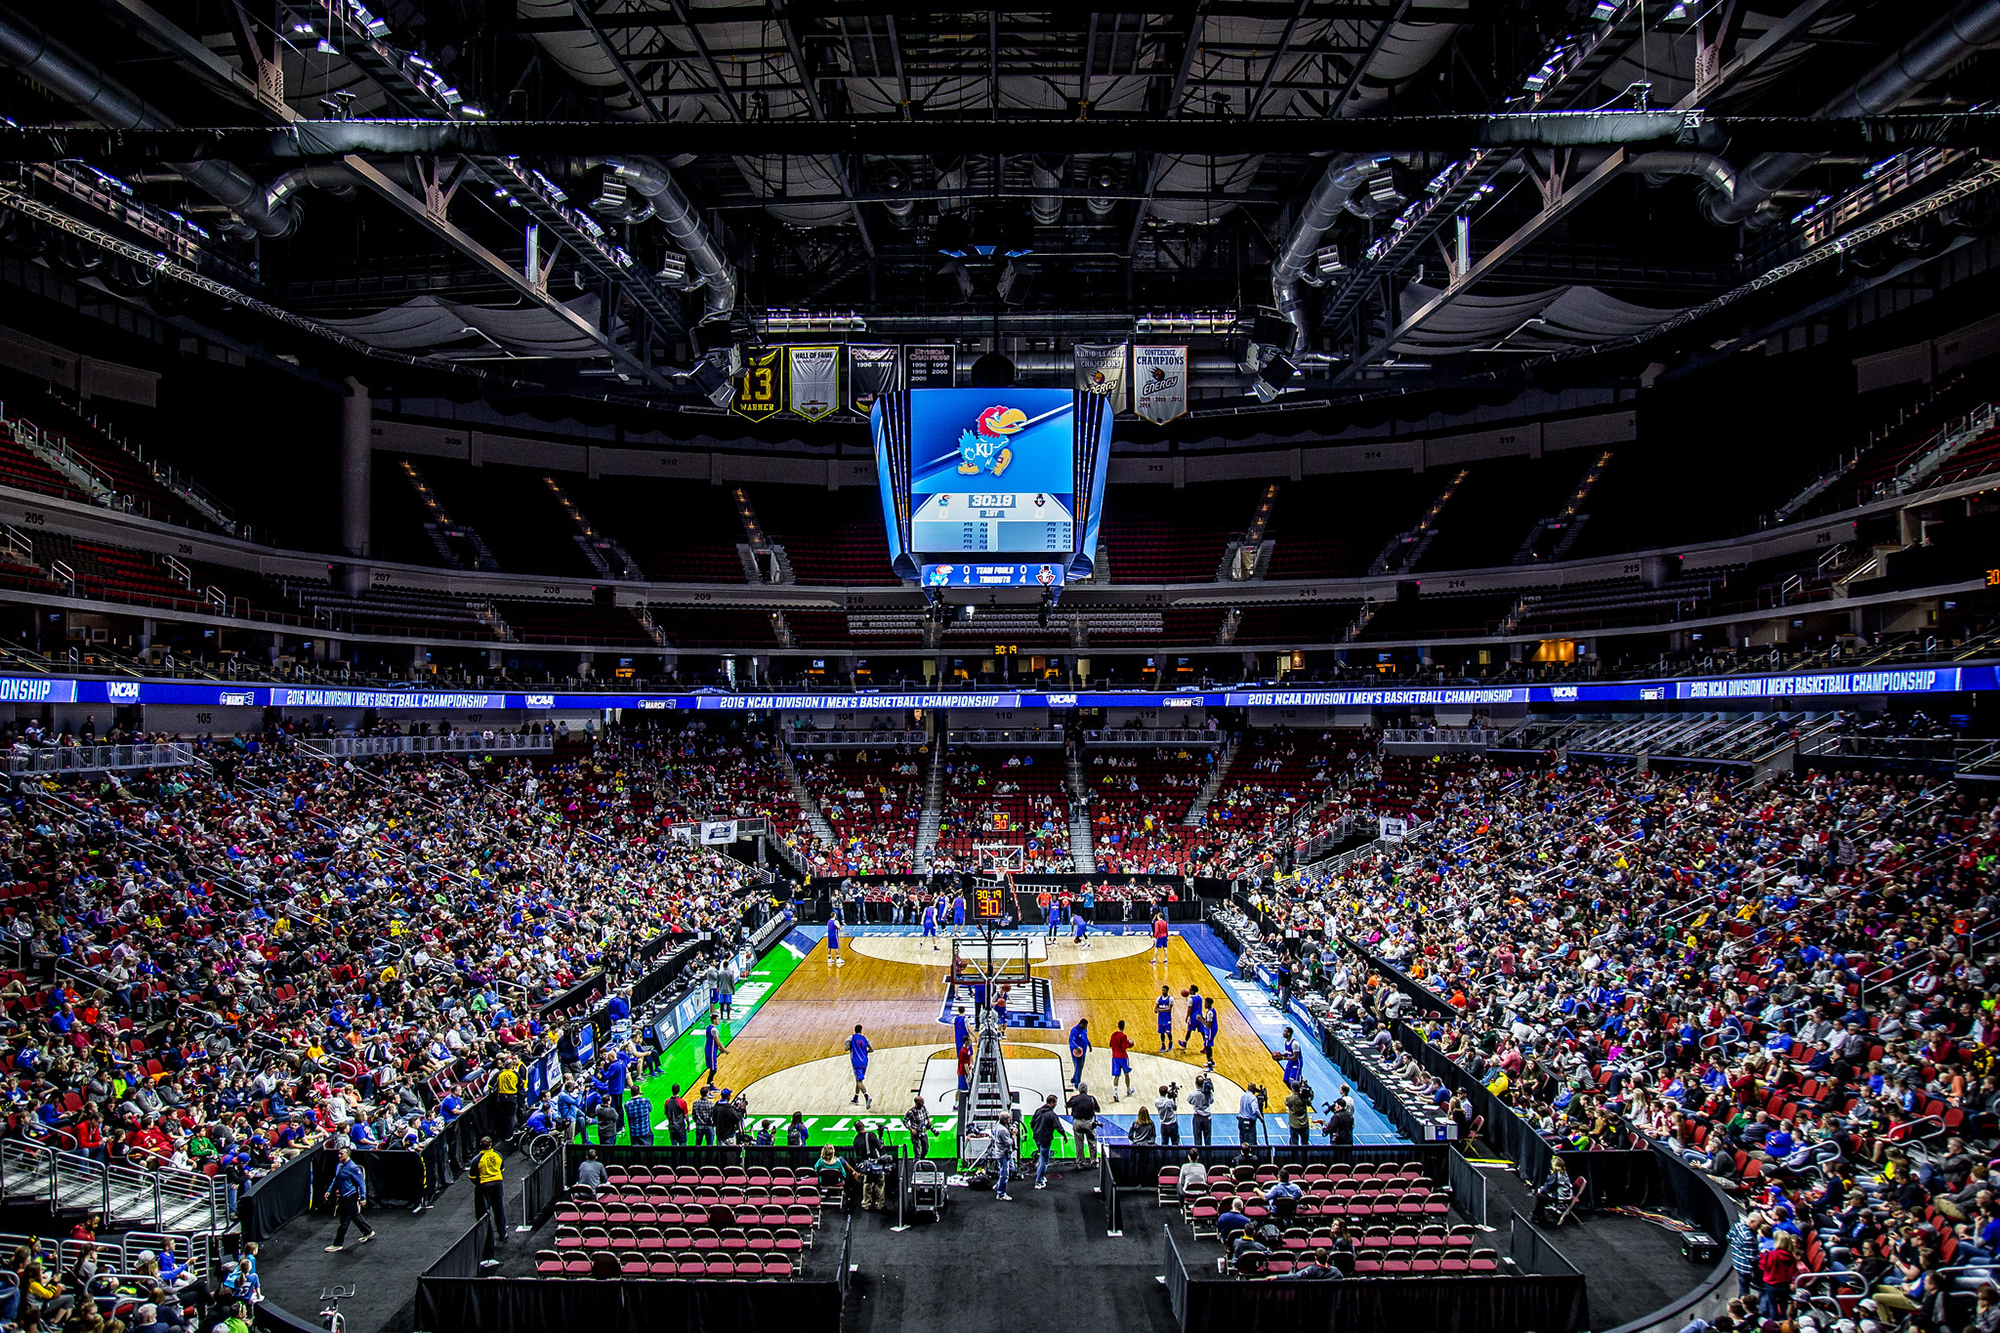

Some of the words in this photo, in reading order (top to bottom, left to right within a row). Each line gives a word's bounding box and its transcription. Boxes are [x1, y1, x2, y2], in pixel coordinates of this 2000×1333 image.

[1080, 360, 1121, 368] CHAMPIONS
[1136, 356, 1185, 365] CHAMPIONS
[741, 367, 773, 401] 13
[1142, 376, 1179, 396] ENERGY
[740, 403, 774, 411] WARNER
[975, 443, 994, 457] KU
[1365, 451, 1381, 459] 314
[661, 458, 677, 466] 310
[971, 494, 1013, 507] 30:19
[25, 512, 45, 525] 205
[938, 508, 949, 519] 0
[1034, 508, 1046, 519] 0
[1816, 532, 1831, 544] 216
[178, 543, 193, 556] 206
[963, 565, 970, 574] 0
[994, 566, 1014, 574] FOULS
[1020, 564, 1027, 574] 0
[1623, 564, 1639, 574] 215
[374, 572, 391, 582] 207
[963, 575, 970, 584] 4
[1019, 575, 1027, 584] 4
[1448, 580, 1466, 589] 214
[543, 586, 561, 595] 208
[1299, 589, 1317, 597] 213
[694, 593, 712, 601] 209
[846, 596, 864, 604] 210
[995, 645, 1018, 655] 30:19
[1690, 683, 1707, 697] 2016
[1708, 682, 1727, 696] NCAA
[1728, 679, 1761, 696] DIVISION
[1767, 677, 1794, 694] MEN'S
[1795, 674, 1851, 694] BASKETBALL
[1852, 671, 1936, 692] CHAMPIONSHIP
[0, 680, 51, 700] ONSHIP
[110, 682, 138, 697] NCAA
[1553, 687, 1577, 697] NCAA
[226, 695, 244, 706] MARCH
[287, 691, 304, 705] 2016
[305, 691, 323, 705] NCAA
[324, 692, 351, 706] DIVISION
[356, 693, 374, 707] MEN'S
[375, 693, 420, 708] BASKETBALL
[421, 694, 488, 708] CHAMPIONSHIP
[527, 695, 554, 705] NCAA
[719, 698, 745, 708] 2016
[746, 698, 773, 708] NCAA
[775, 697, 820, 708] DIVISION
[826, 697, 858, 708] MEN'S
[859, 696, 920, 708] BASKETBALL
[921, 695, 1000, 707] CHAMPIONSHIP
[1049, 695, 1077, 704] NCAA
[1247, 693, 1273, 705] 2016
[1274, 693, 1302, 704] NCAA
[1303, 693, 1345, 704] DIVISION
[1347, 692, 1352, 704] I
[1353, 692, 1382, 704] MEN'S
[1384, 690, 1443, 703] BASKETBALL
[1445, 689, 1513, 702] CHAMPIONSHIP
[645, 701, 665, 709] MARCH
[1170, 698, 1192, 707] MARCH
[196, 712, 212, 724] 105
[468, 714, 483, 723] 107
[837, 712, 854, 720] 108
[995, 712, 1012, 720] 110
[1139, 711, 1157, 719] 112
[1280, 710, 1296, 718] 112
[977, 889, 1002, 900] 30:19
[980, 899, 999, 916] 30
[822, 1118, 958, 1132] FRST
